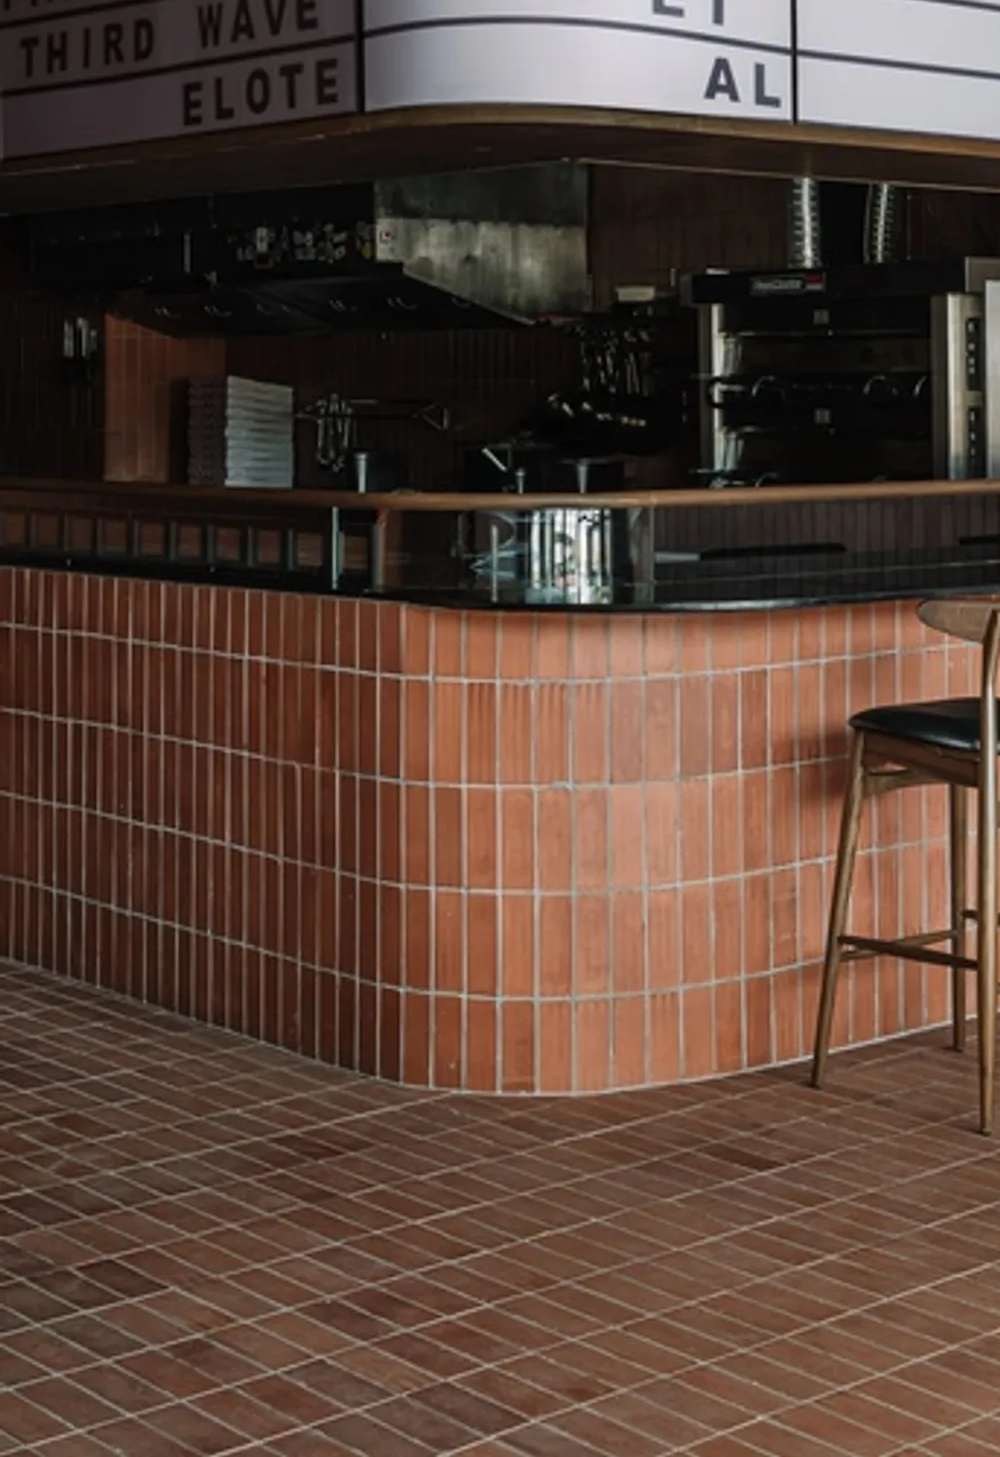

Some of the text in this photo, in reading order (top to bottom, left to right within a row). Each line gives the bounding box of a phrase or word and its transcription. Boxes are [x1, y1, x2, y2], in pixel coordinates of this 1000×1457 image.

[21, 18, 154, 77] THIRD
[183, 59, 338, 125] ELOTE
[704, 58, 781, 108] AL
